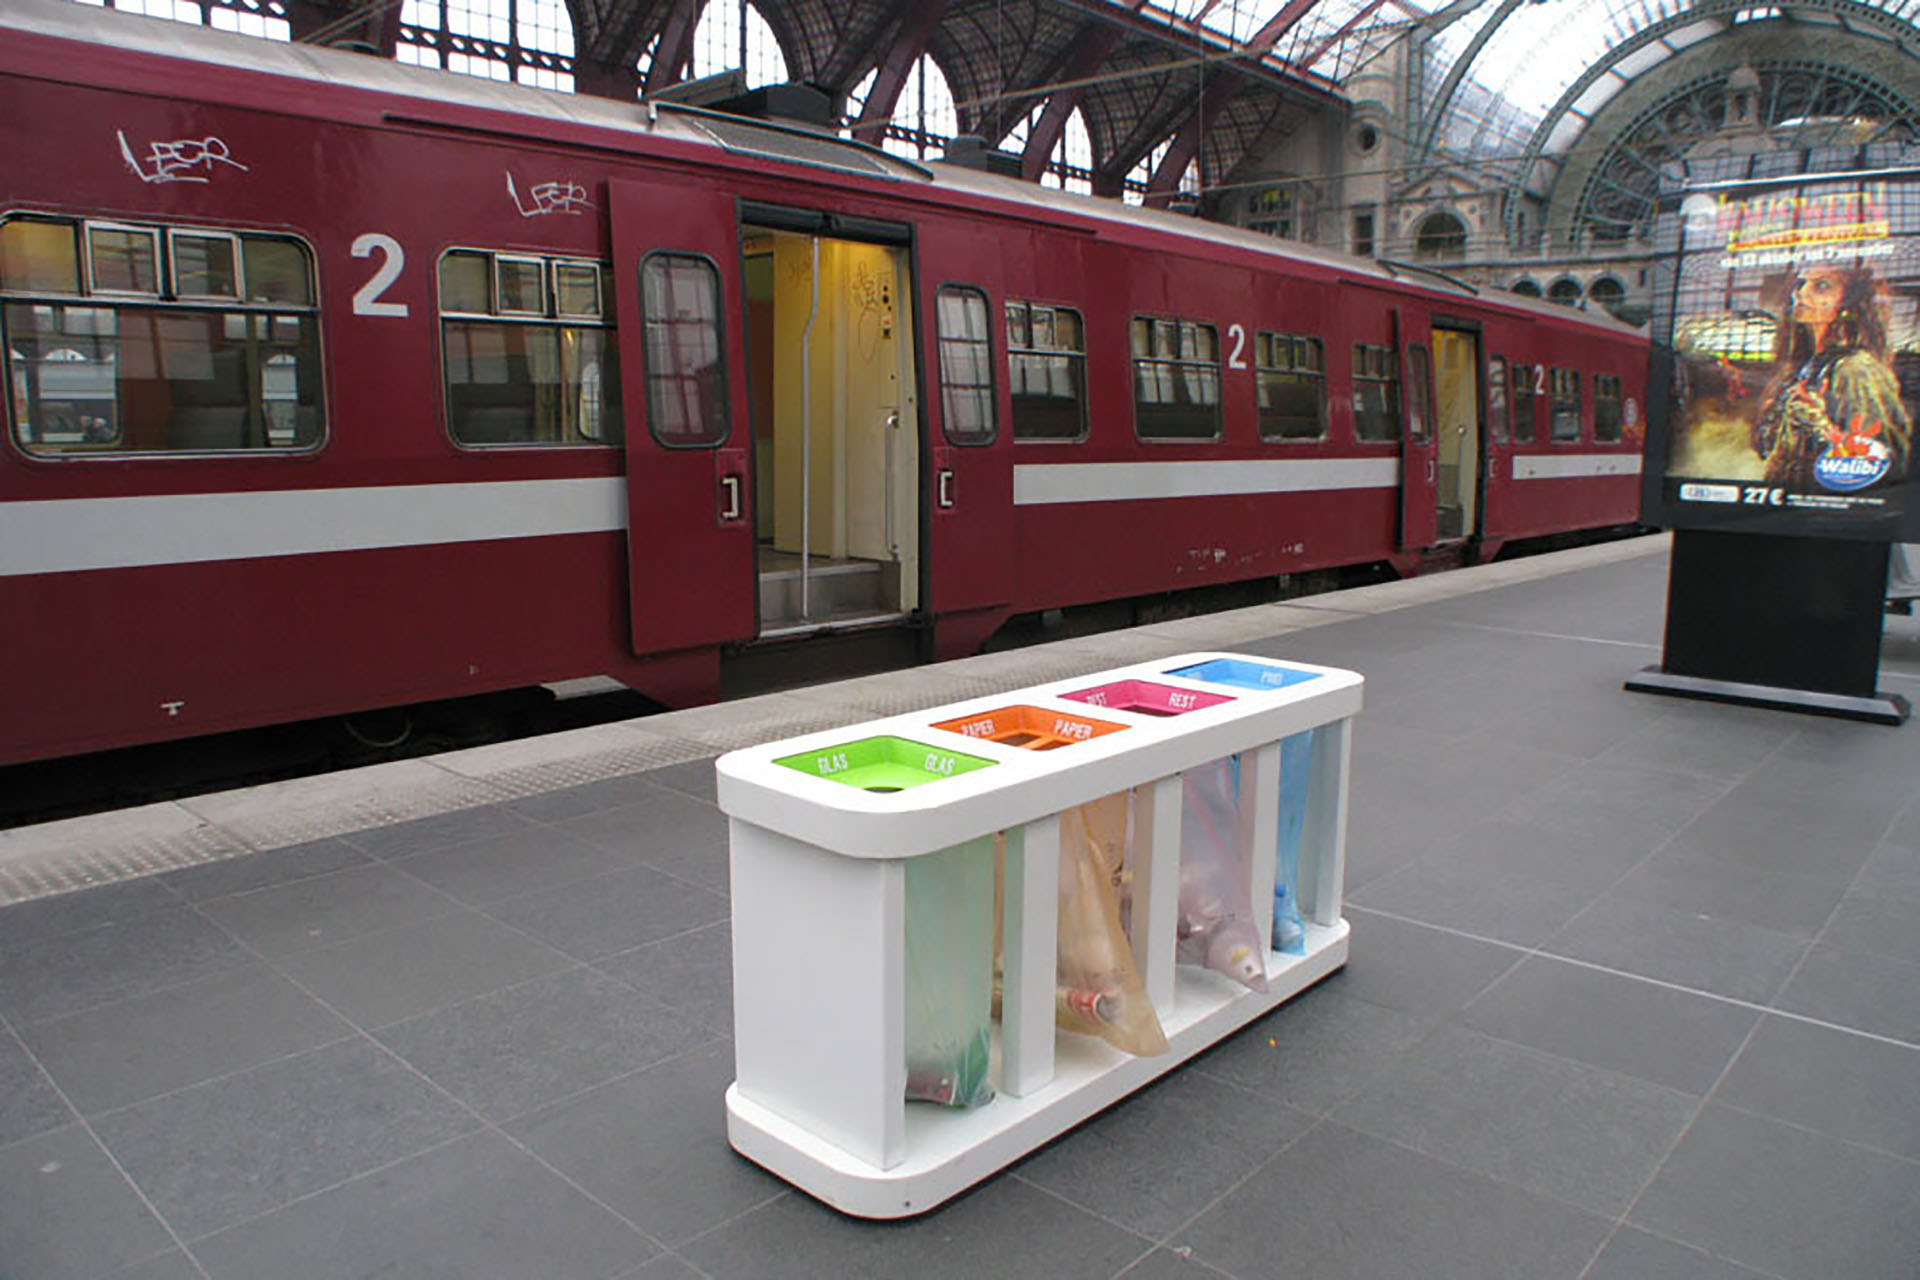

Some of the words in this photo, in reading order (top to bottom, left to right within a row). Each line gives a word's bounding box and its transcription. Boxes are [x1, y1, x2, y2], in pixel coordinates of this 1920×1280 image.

[350, 232, 408, 317] 2
[1228, 323, 1247, 369] 2
[1535, 364, 1545, 395] 2
[1819, 458, 1882, 476] Walibi
[1168, 691, 1197, 709] REST
[1053, 719, 1093, 740] PAPIER
[817, 753, 849, 775] GLAS
[924, 753, 956, 775] GLAS
